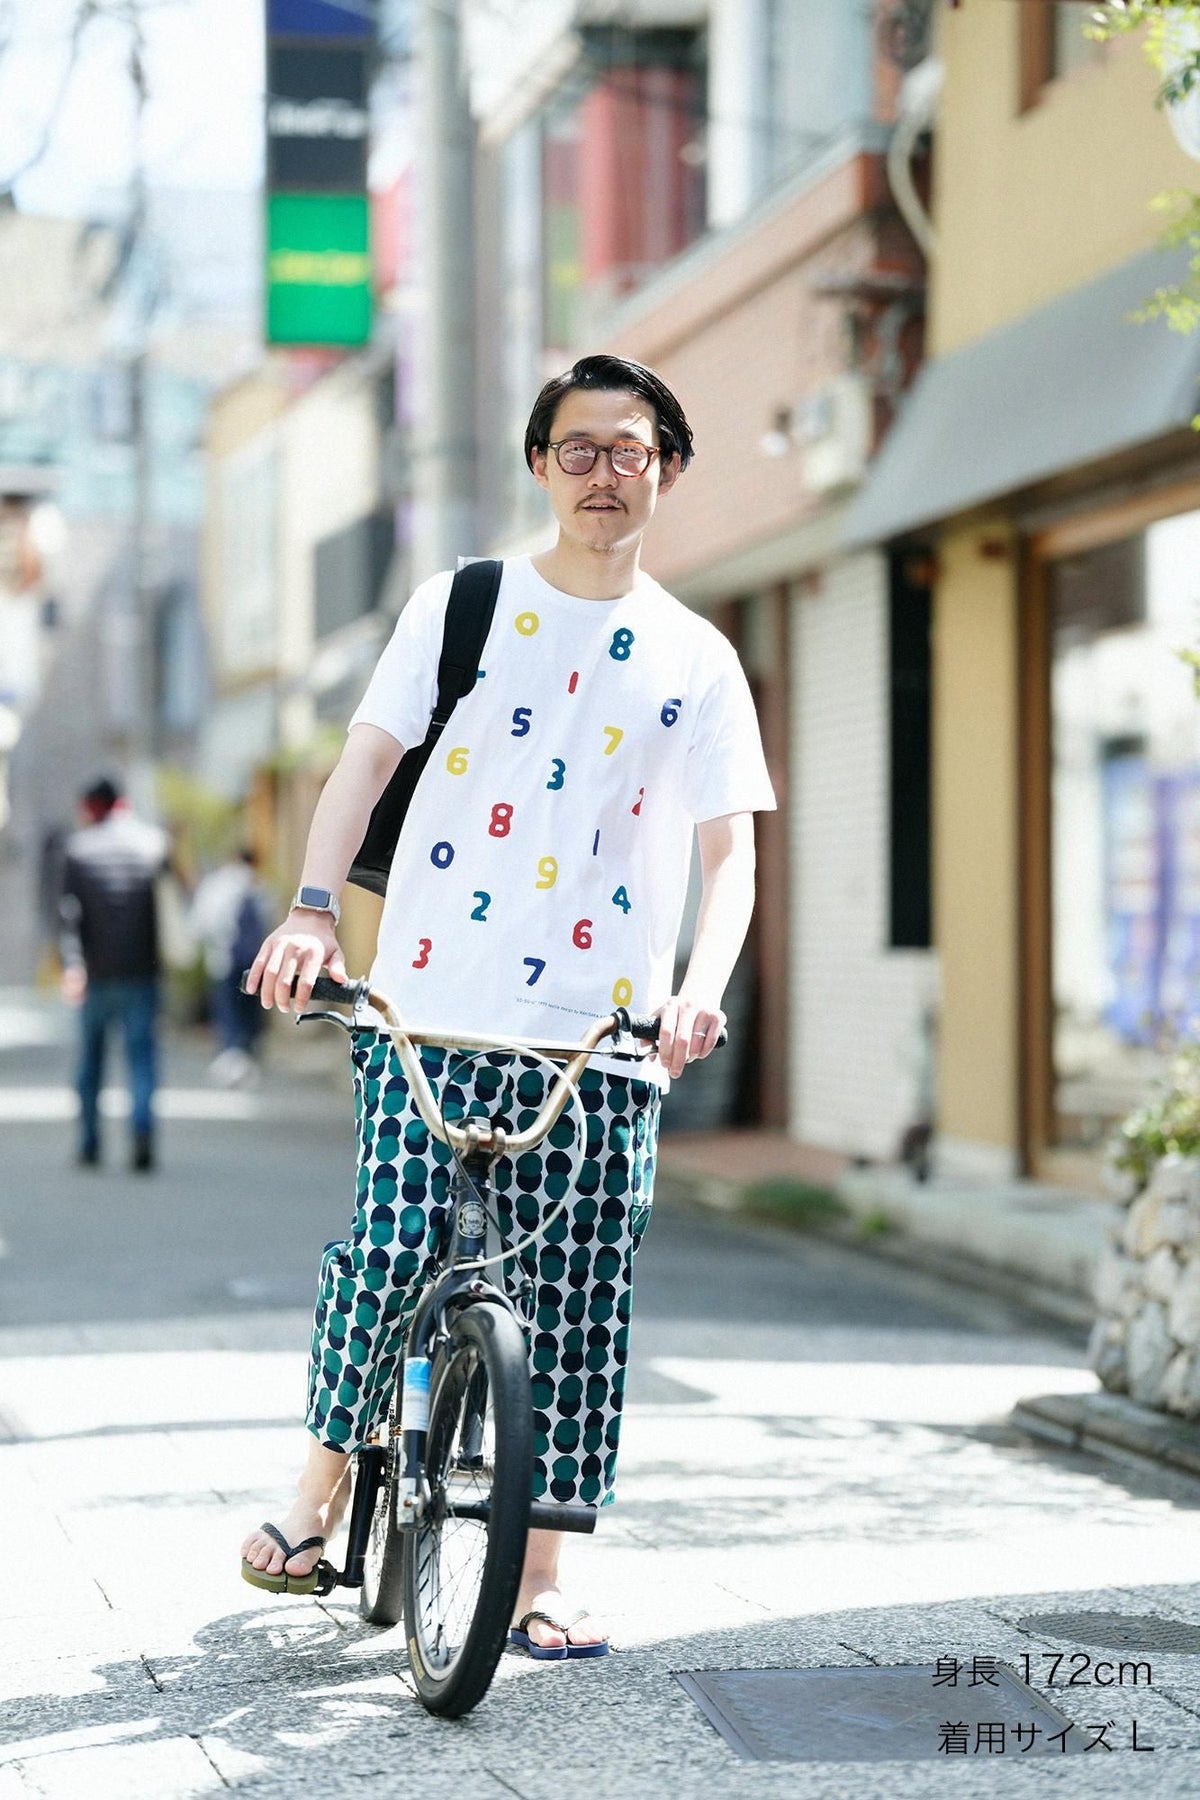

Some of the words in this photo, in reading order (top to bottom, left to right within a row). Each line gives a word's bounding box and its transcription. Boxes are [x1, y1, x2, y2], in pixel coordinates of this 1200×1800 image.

[515, 612, 539, 636] 0
[609, 628, 635, 661] 8
[511, 707, 532, 737] 5
[661, 699, 682, 727] 6
[604, 727, 624, 755] 7
[446, 747, 470, 775] 6
[546, 758, 566, 791] 3
[488, 803, 514, 838] 8
[430, 841, 455, 869] 0
[536, 856, 558, 889] 9
[471, 891, 491, 921] 2
[612, 886, 632, 914] 4
[572, 919, 593, 950] 6
[412, 938, 432, 969] 3
[523, 957, 546, 986] 7
[612, 978, 632, 1007] 0
